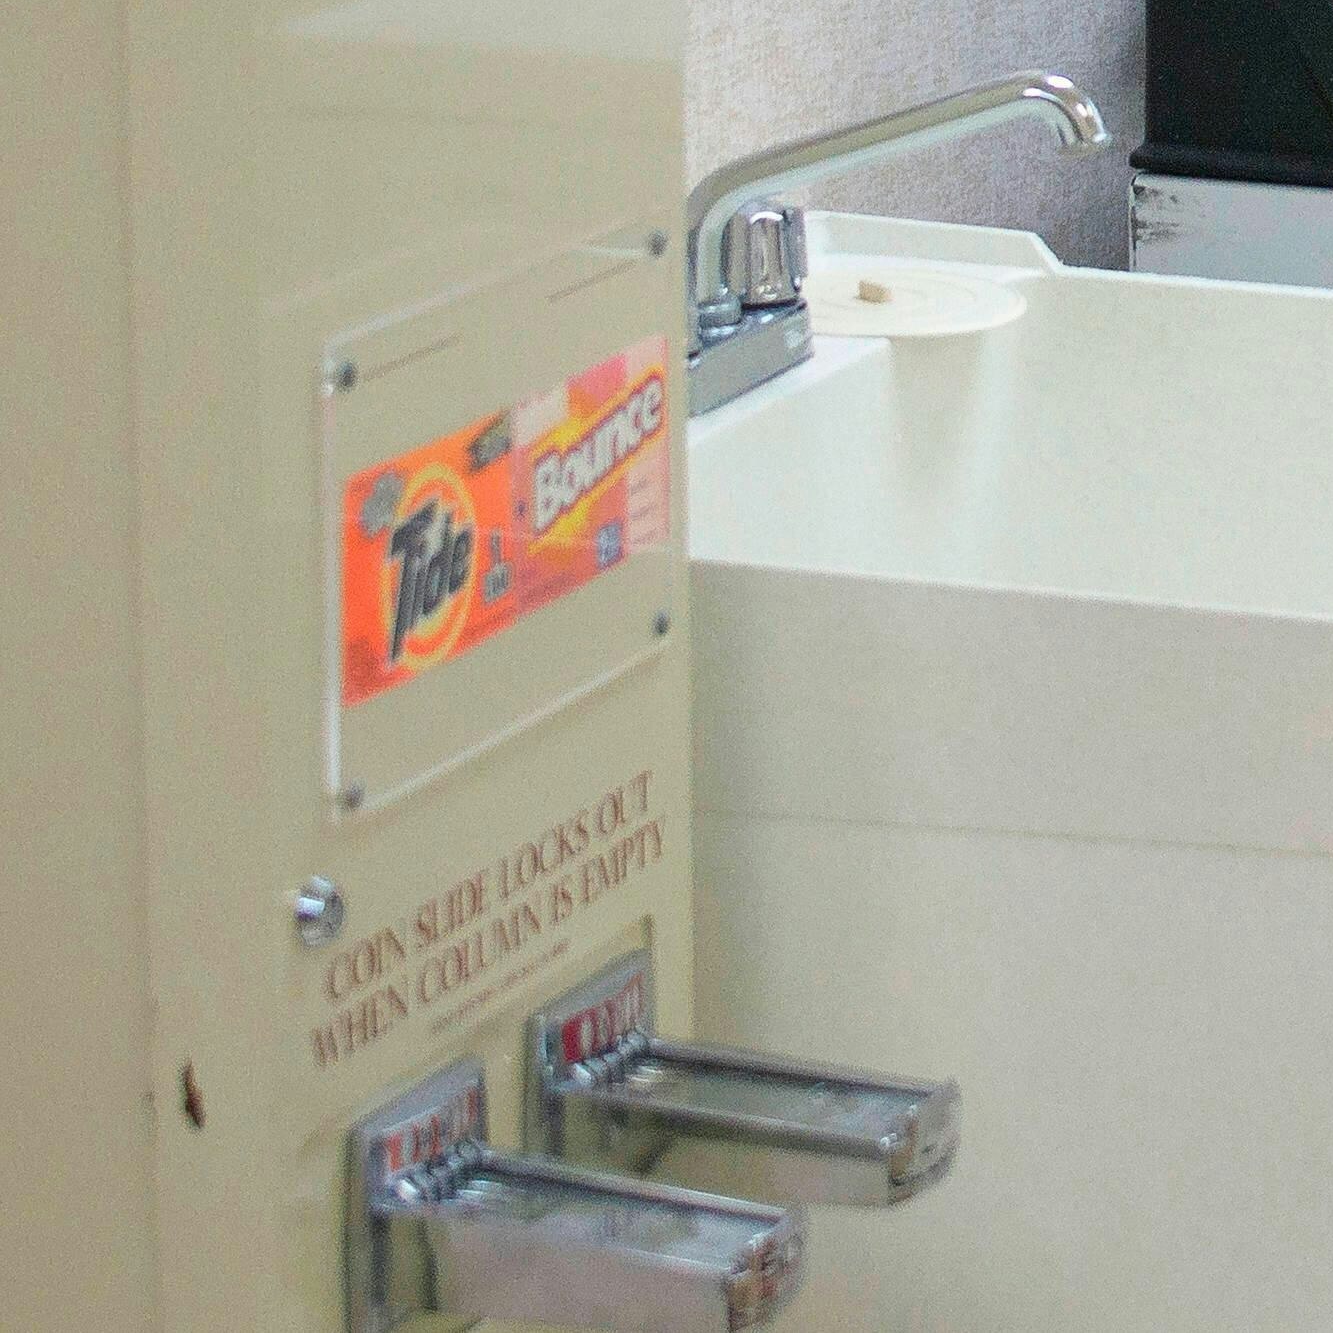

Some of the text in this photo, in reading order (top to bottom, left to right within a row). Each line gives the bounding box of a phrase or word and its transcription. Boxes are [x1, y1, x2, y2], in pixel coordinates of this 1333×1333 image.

[532, 375, 664, 535] Bounce
[387, 497, 474, 668] Tide
[312, 974, 411, 1068] WHEN
[415, 889, 543, 1004] COLUMN
[550, 874, 574, 926] IS
[575, 813, 667, 906] EMPTY
[324, 927, 406, 1004] COIN
[413, 869, 489, 953] SLIDE
[496, 808, 591, 900] LOCKS
[597, 769, 652, 837] OUT
